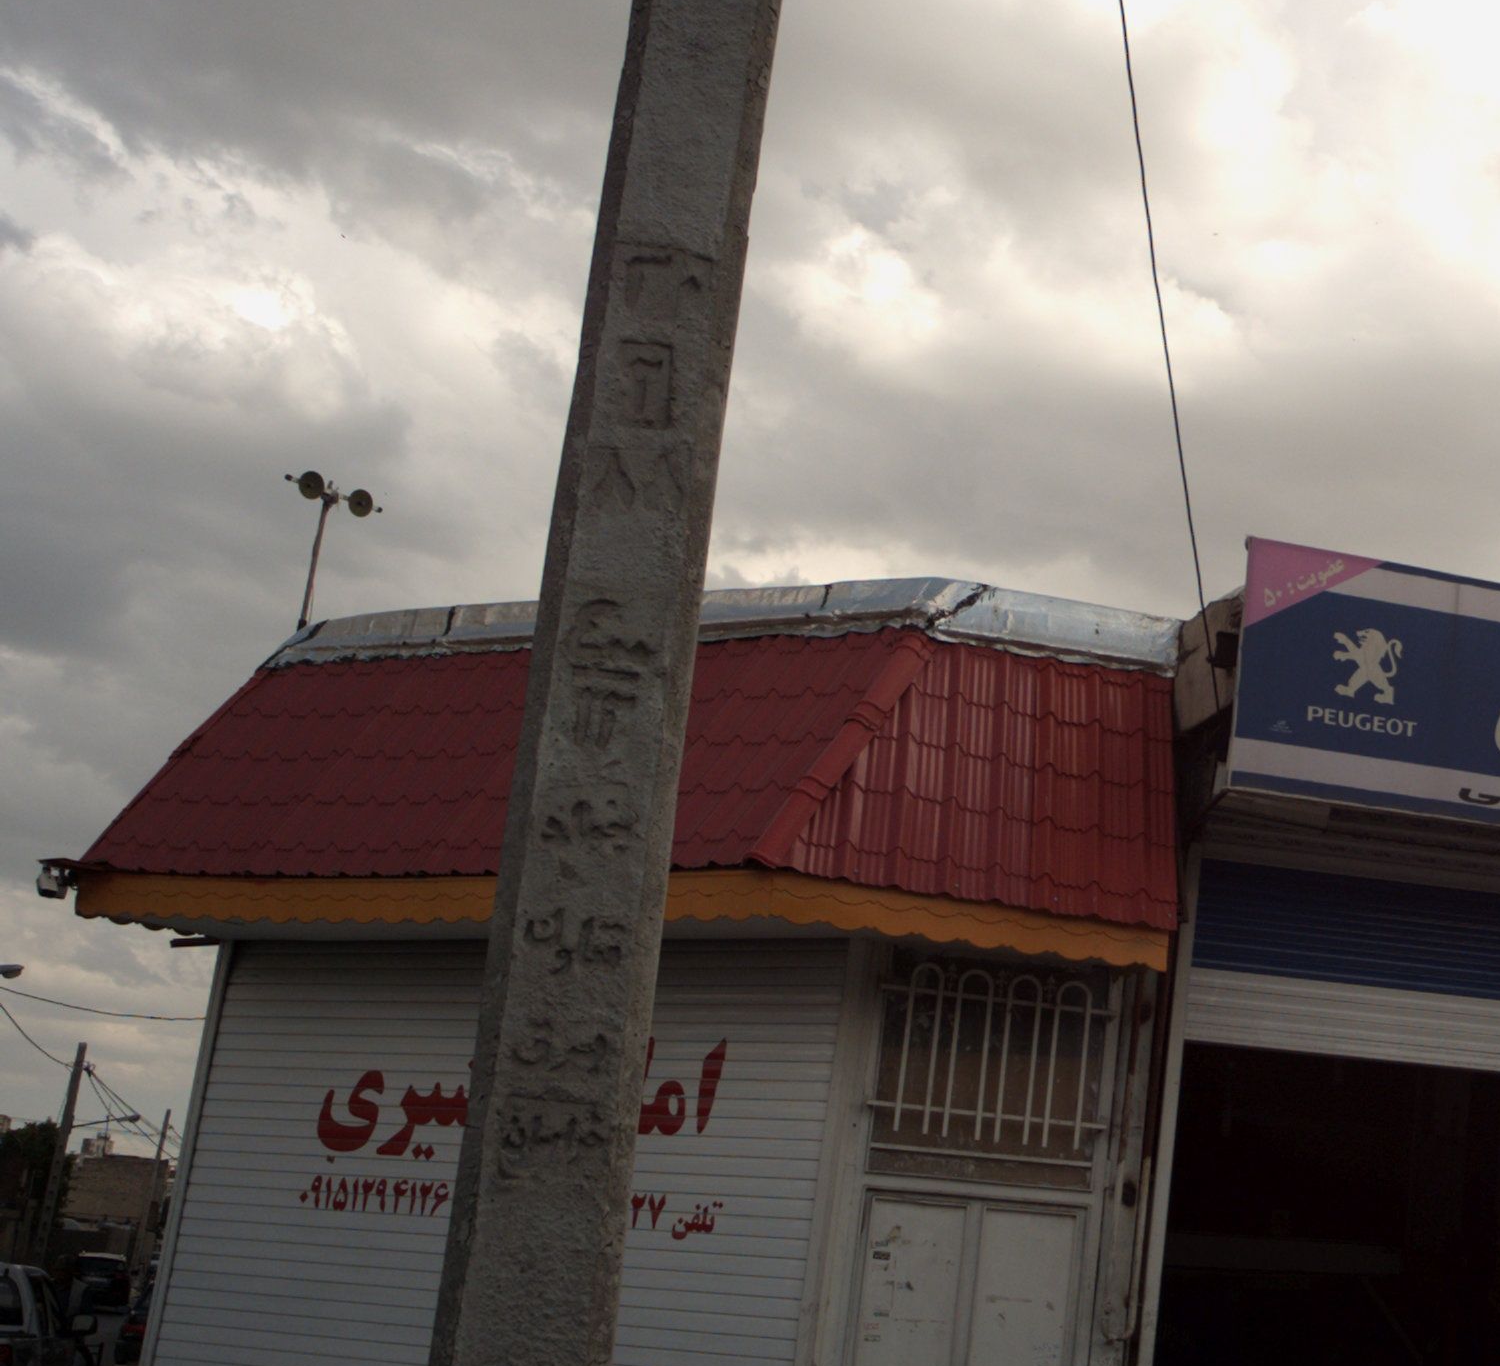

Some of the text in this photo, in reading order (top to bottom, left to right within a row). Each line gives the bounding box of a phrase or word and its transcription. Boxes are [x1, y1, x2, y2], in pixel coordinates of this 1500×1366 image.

[1306, 705, 1418, 738] PEUGEOT
[298, 1174, 451, 1218] ۰۹۱۵۱۲۹۴۱۲۶
[671, 1199, 725, 1240] تلفن
